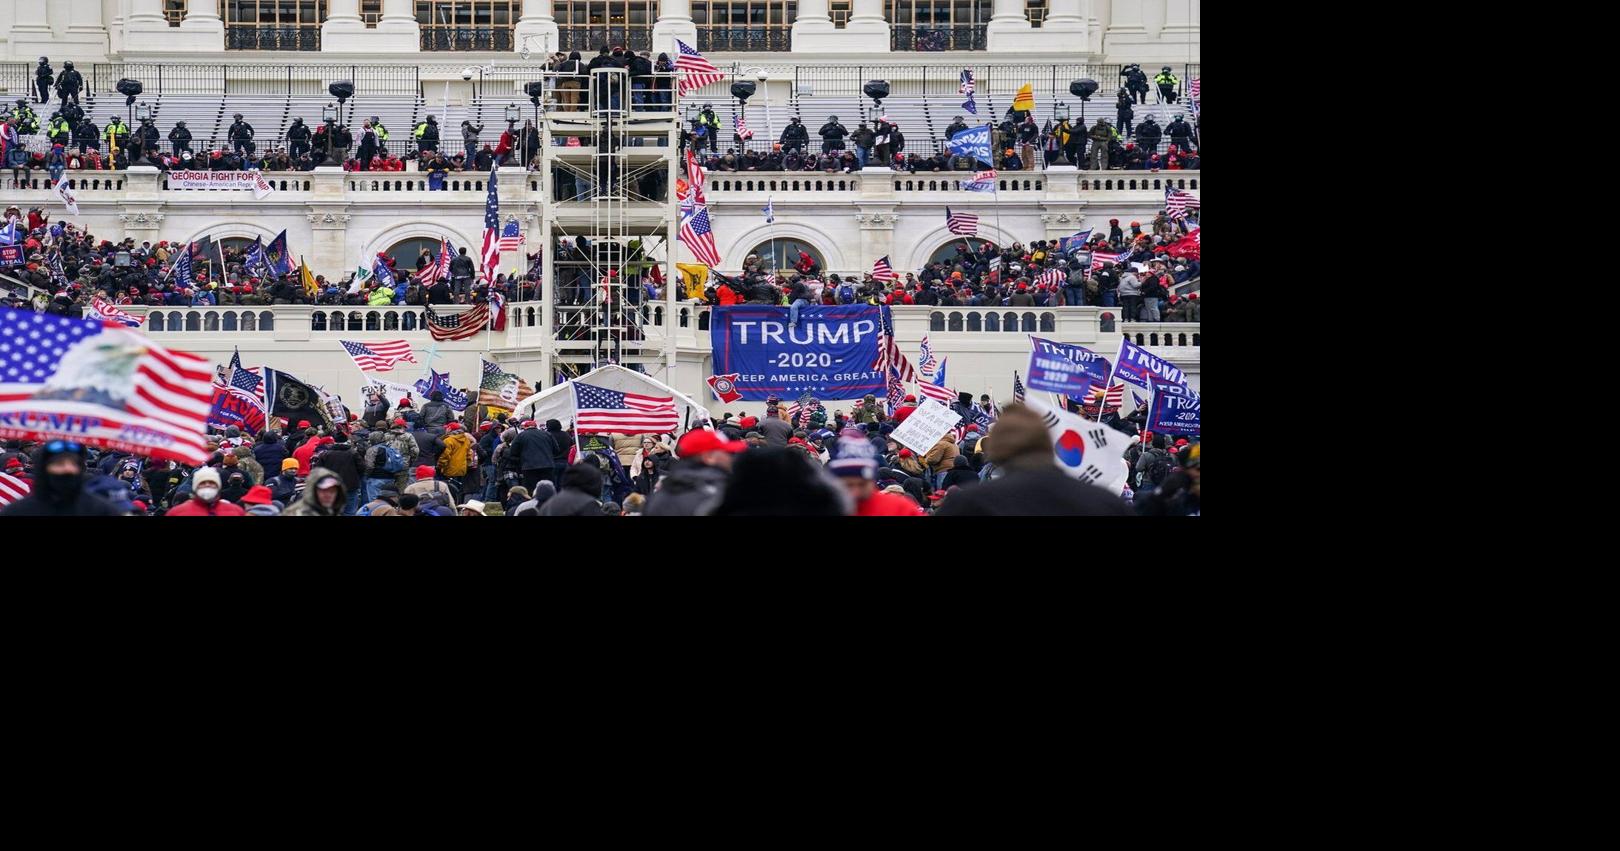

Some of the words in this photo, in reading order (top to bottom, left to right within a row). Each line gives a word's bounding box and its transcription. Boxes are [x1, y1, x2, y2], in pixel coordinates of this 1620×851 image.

[172, 172, 208, 180] GEORGIA
[210, 172, 234, 180] FIGHT
[236, 172, 254, 180] FOR
[732, 320, 875, 345] TRUMP
[768, 352, 844, 368] -2020-
[1036, 358, 1086, 374] TRUMP
[1127, 345, 1188, 385] TRUMP
[770, 374, 829, 382] AMERICA
[834, 371, 882, 382] GREAT!
[1120, 369, 1130, 378] NO
[212, 388, 266, 432] TRUM
